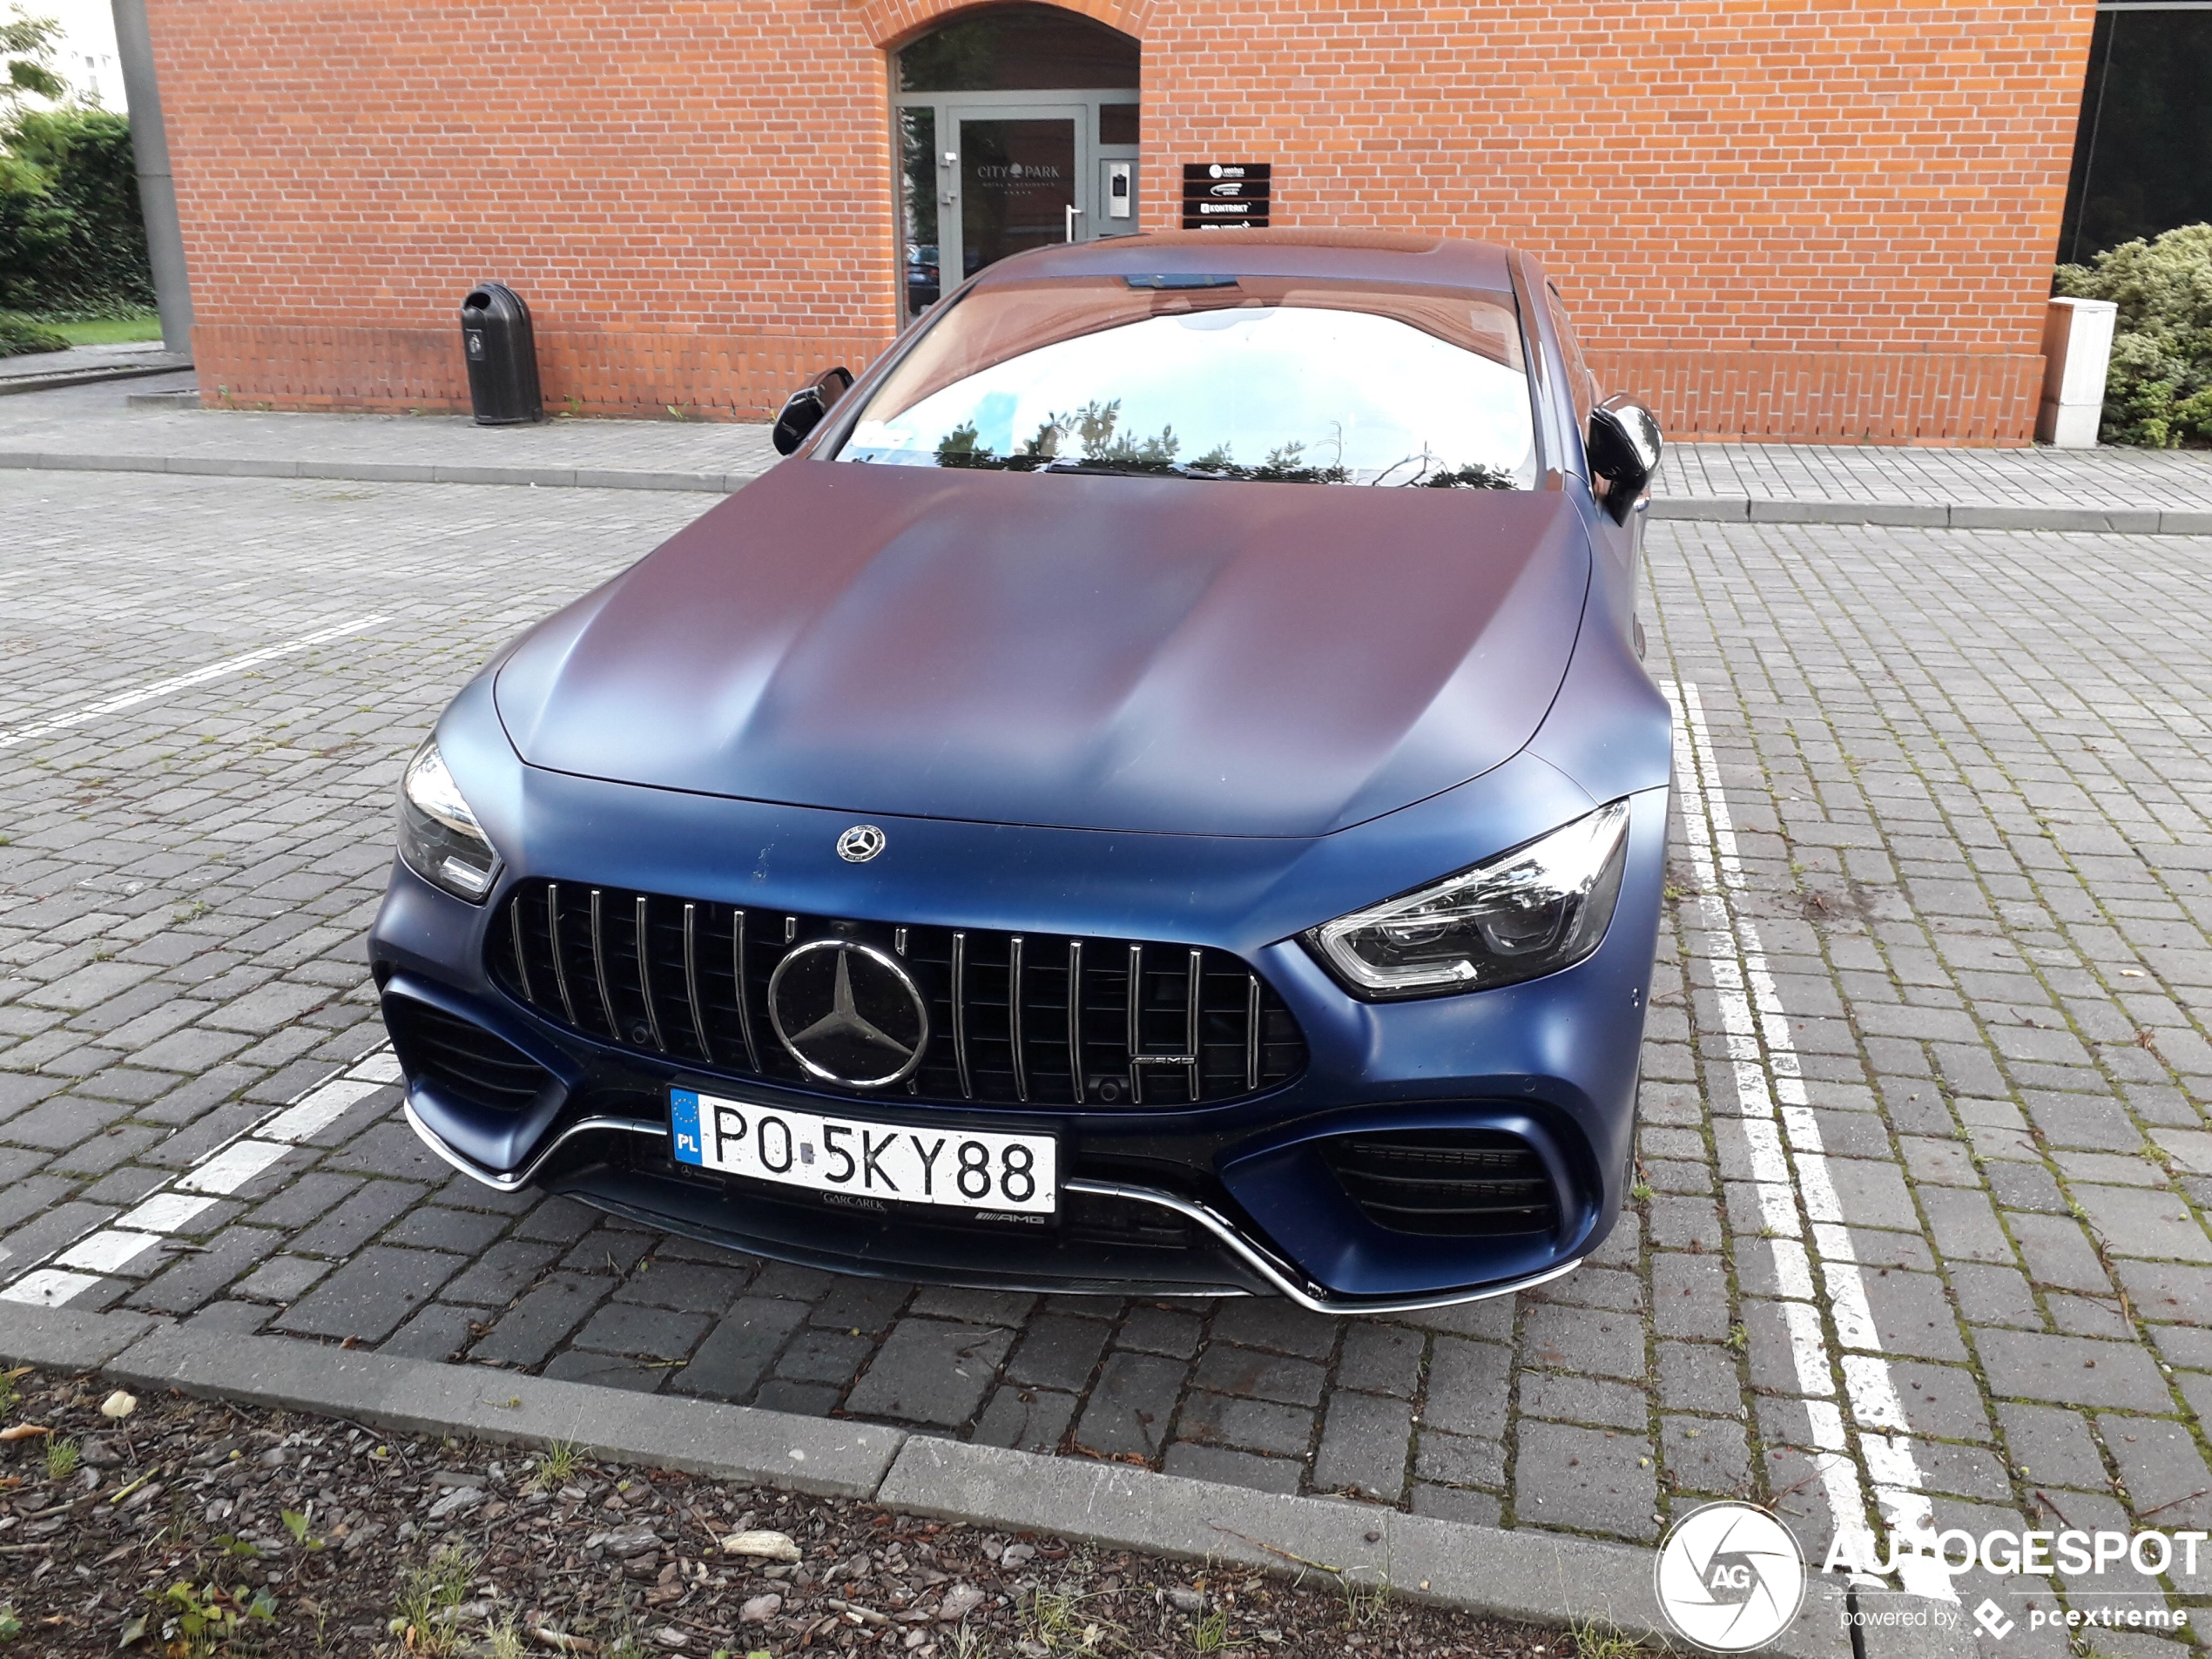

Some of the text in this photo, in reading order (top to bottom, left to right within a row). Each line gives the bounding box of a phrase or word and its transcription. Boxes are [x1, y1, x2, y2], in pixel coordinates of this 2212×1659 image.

[977, 165, 1060, 178] CITY PARK
[1210, 204, 1249, 213] KONTRAKT
[678, 1134, 698, 1153] PL
[713, 1104, 1036, 1203] PO 5KY88
[996, 1214, 1045, 1224] AMG
